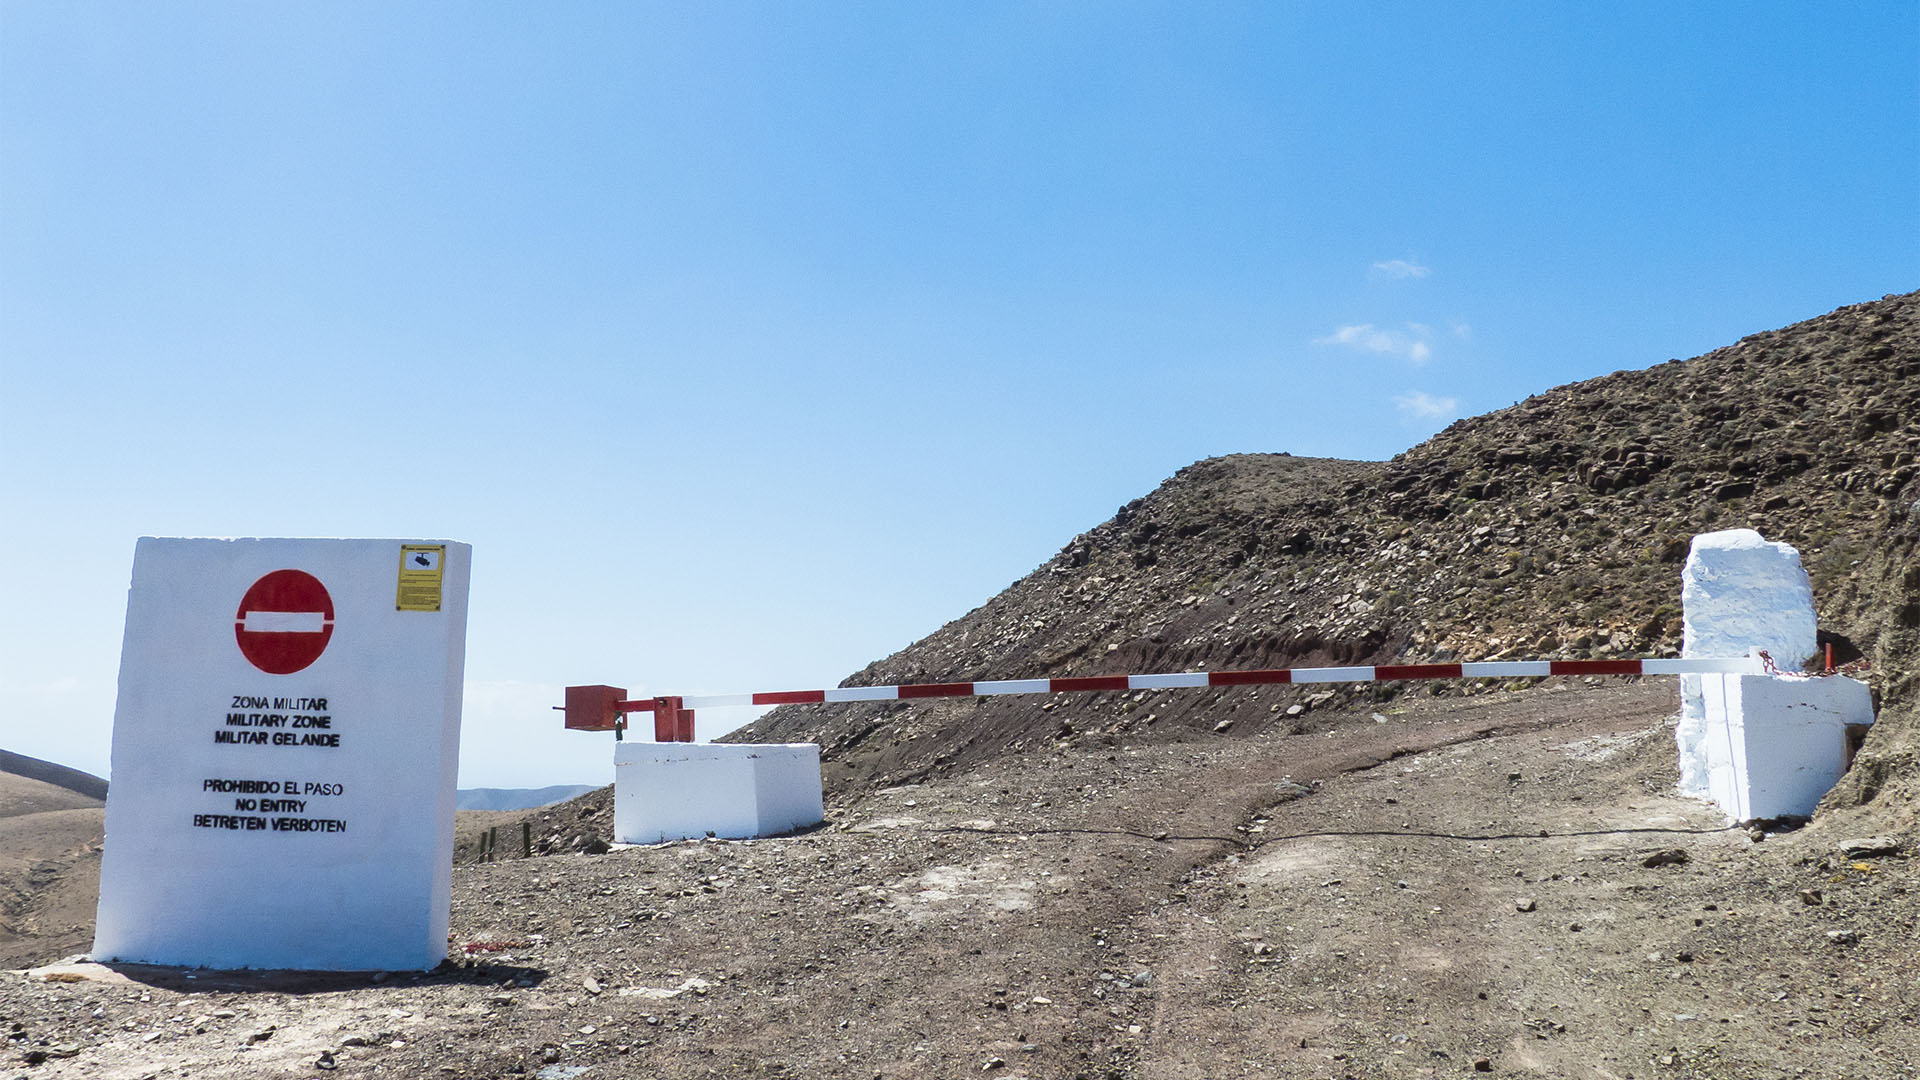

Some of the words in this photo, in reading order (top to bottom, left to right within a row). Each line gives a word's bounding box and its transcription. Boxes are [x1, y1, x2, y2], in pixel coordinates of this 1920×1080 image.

[231, 696, 270, 710] ZONA
[273, 697, 328, 711] MILITAR
[226, 713, 289, 728] MILITARY
[291, 715, 332, 729] ZONE
[214, 730, 269, 745] MILITAR
[272, 732, 341, 748] GELANDE
[203, 779, 281, 794] PROHIBIDO
[283, 781, 301, 795] EL
[304, 783, 344, 796] PASO
[235, 798, 257, 811] NO
[260, 799, 308, 813] ENTRY
[193, 814, 267, 830] BETRETEN
[271, 817, 347, 833] VERBOTEN
